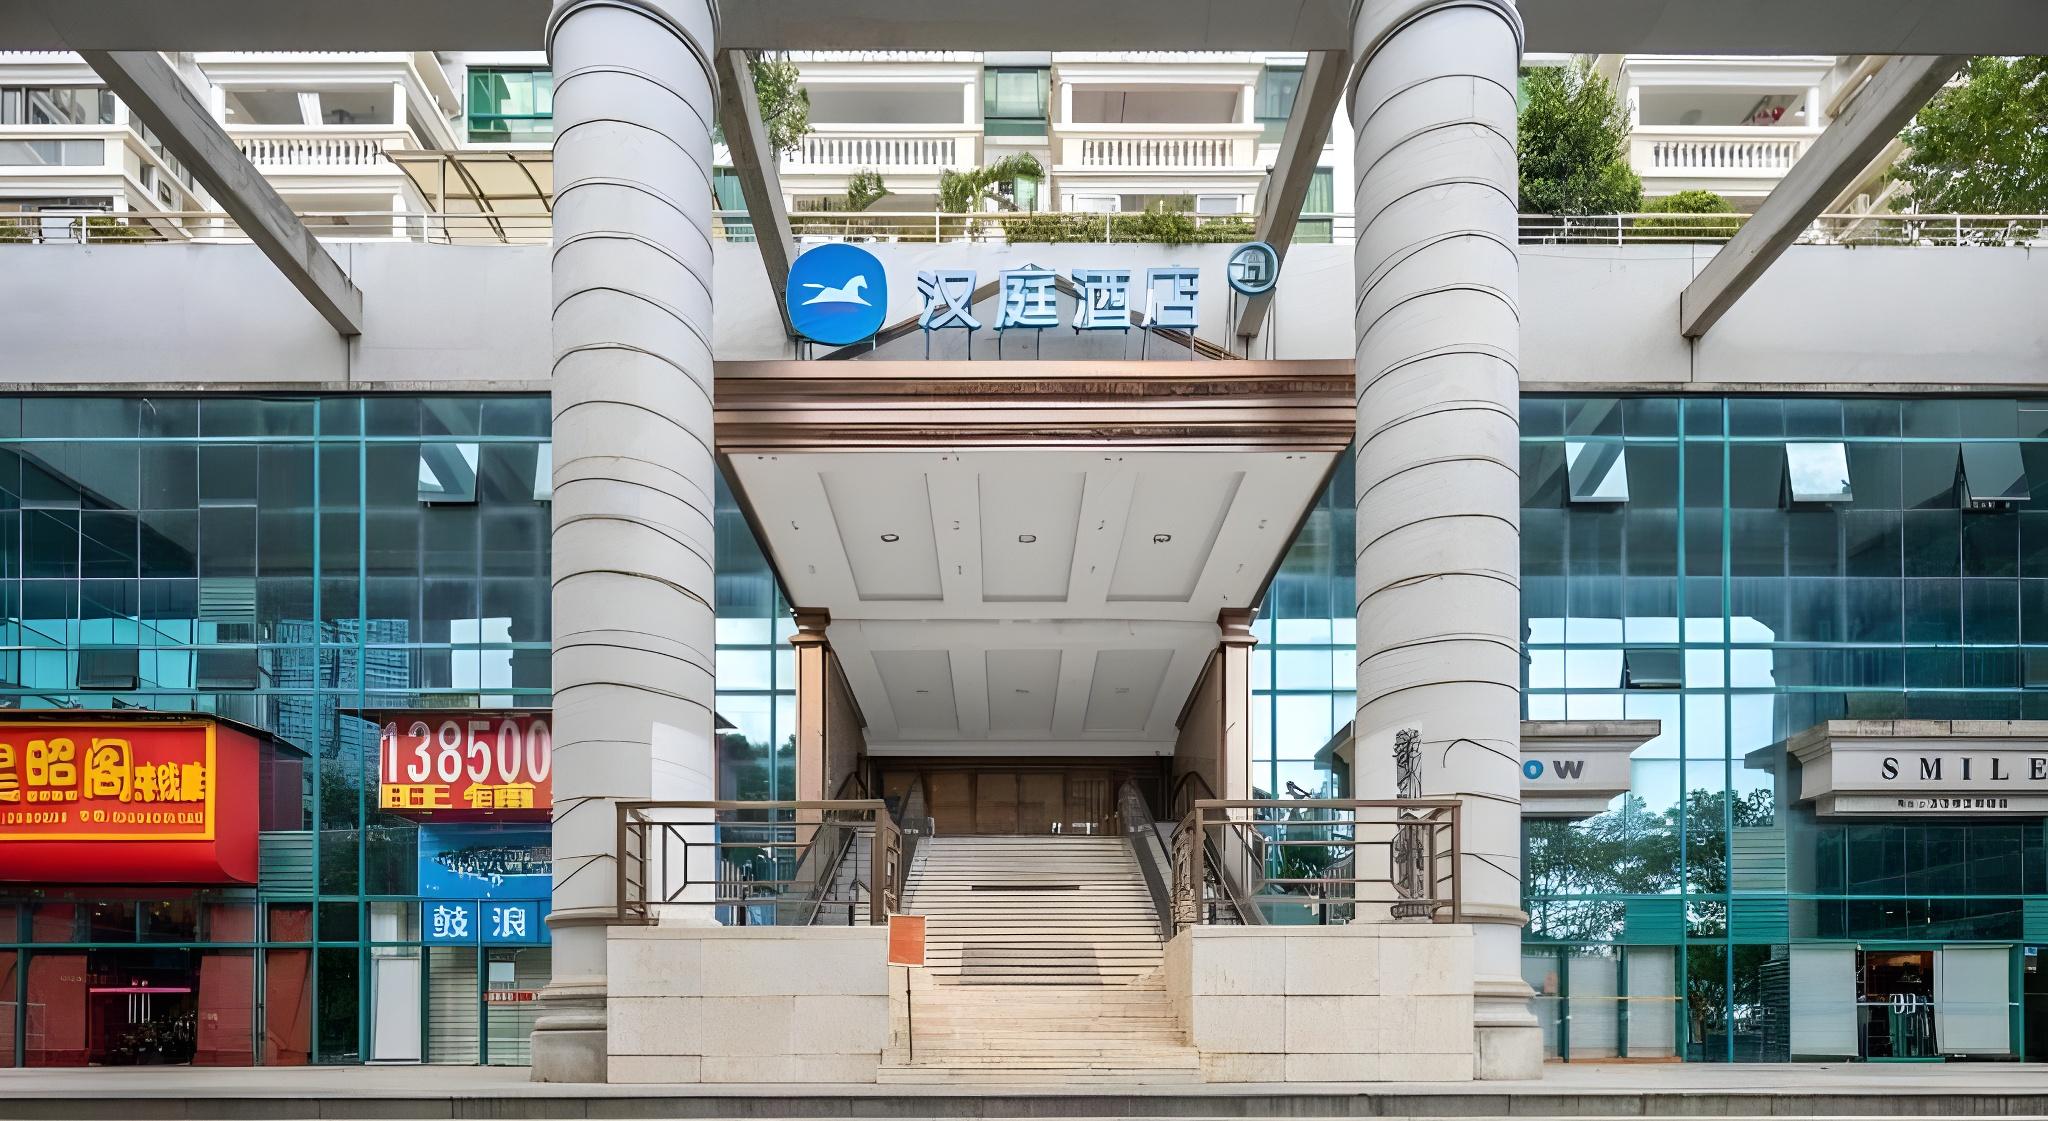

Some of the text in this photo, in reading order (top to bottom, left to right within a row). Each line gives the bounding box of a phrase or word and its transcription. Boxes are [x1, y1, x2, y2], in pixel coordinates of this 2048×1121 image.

[917, 267, 1201, 331] 汉庭酒店
[1881, 757, 2048, 781] SMILE
[433, 904, 526, 938] 鼓浪
